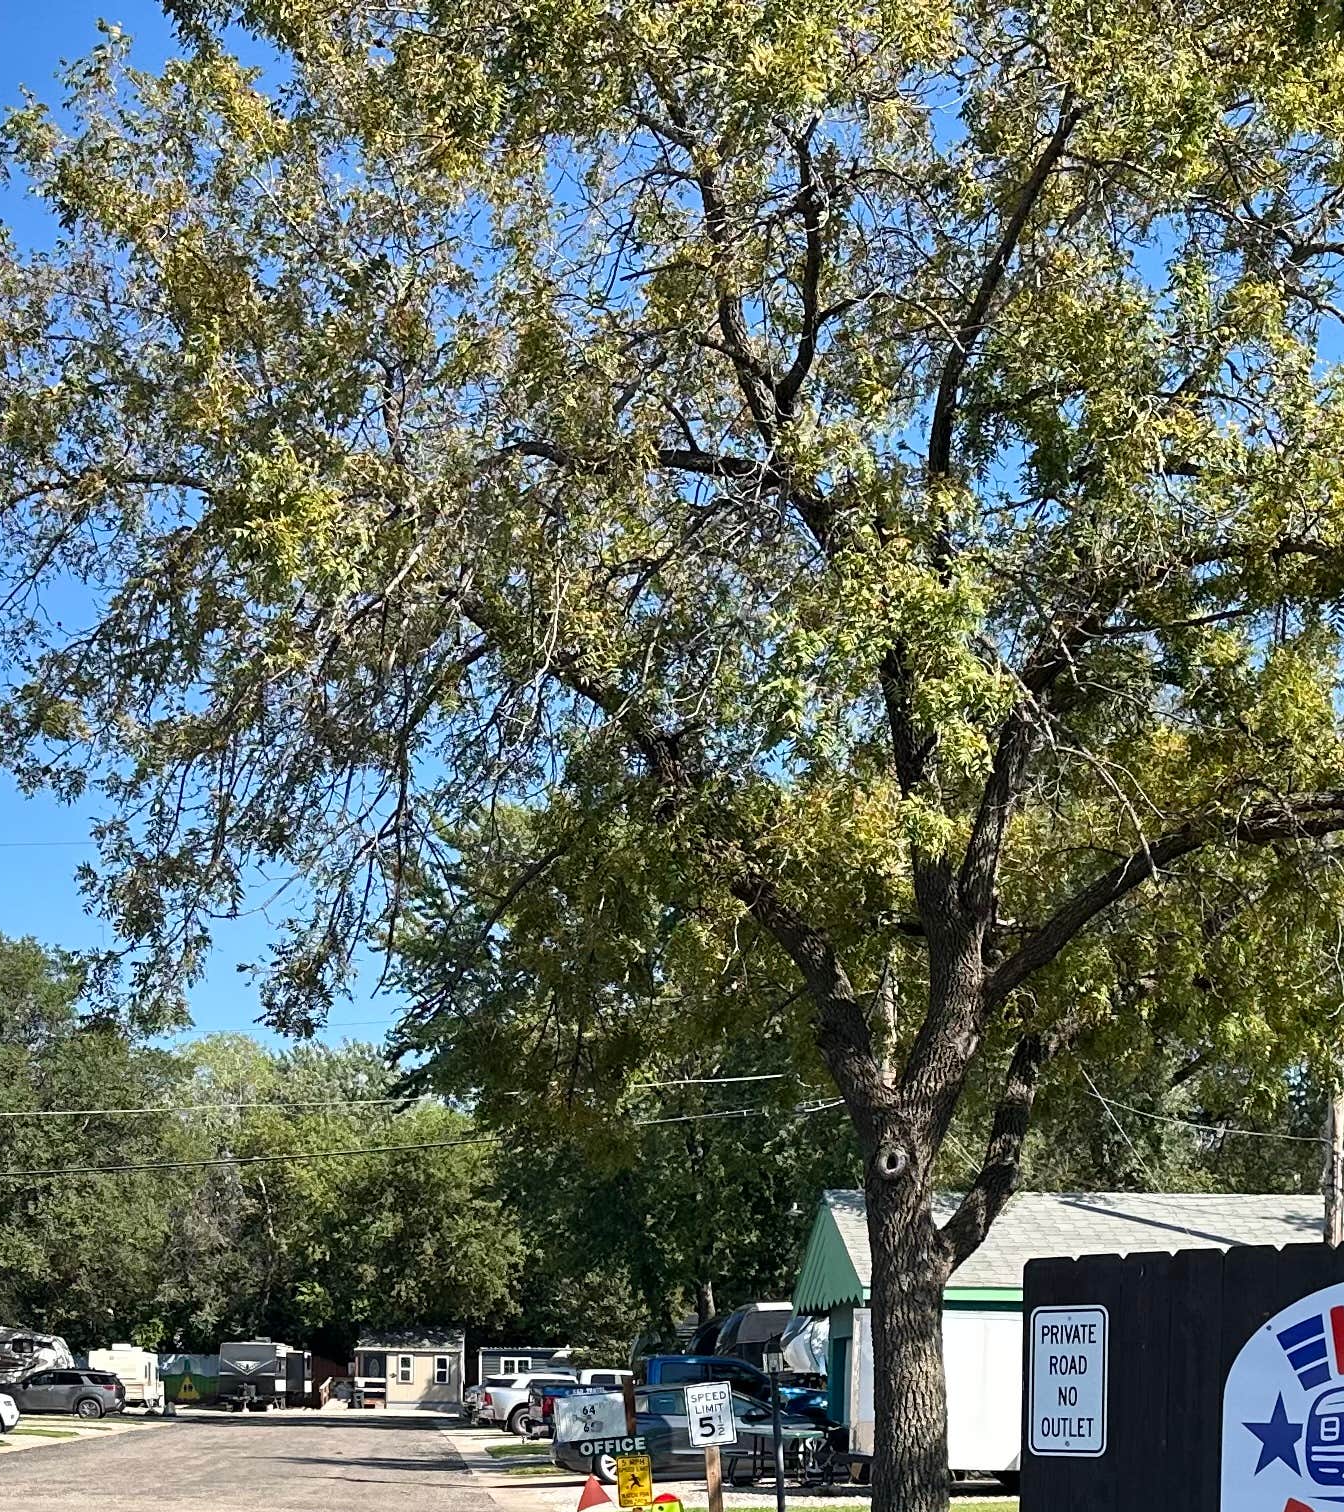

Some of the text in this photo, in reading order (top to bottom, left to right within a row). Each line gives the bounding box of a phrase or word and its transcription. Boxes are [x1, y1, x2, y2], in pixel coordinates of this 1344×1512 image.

[1041, 1324, 1097, 1344] PRIVATE
[1049, 1355, 1087, 1375] ROAD
[691, 1391, 726, 1403] SPEED
[1058, 1386, 1078, 1407] NO
[695, 1403, 723, 1414] LIMIT
[699, 1416, 716, 1437] 5
[1041, 1417, 1094, 1437] OUTLET
[580, 1437, 646, 1455] OFFICE
